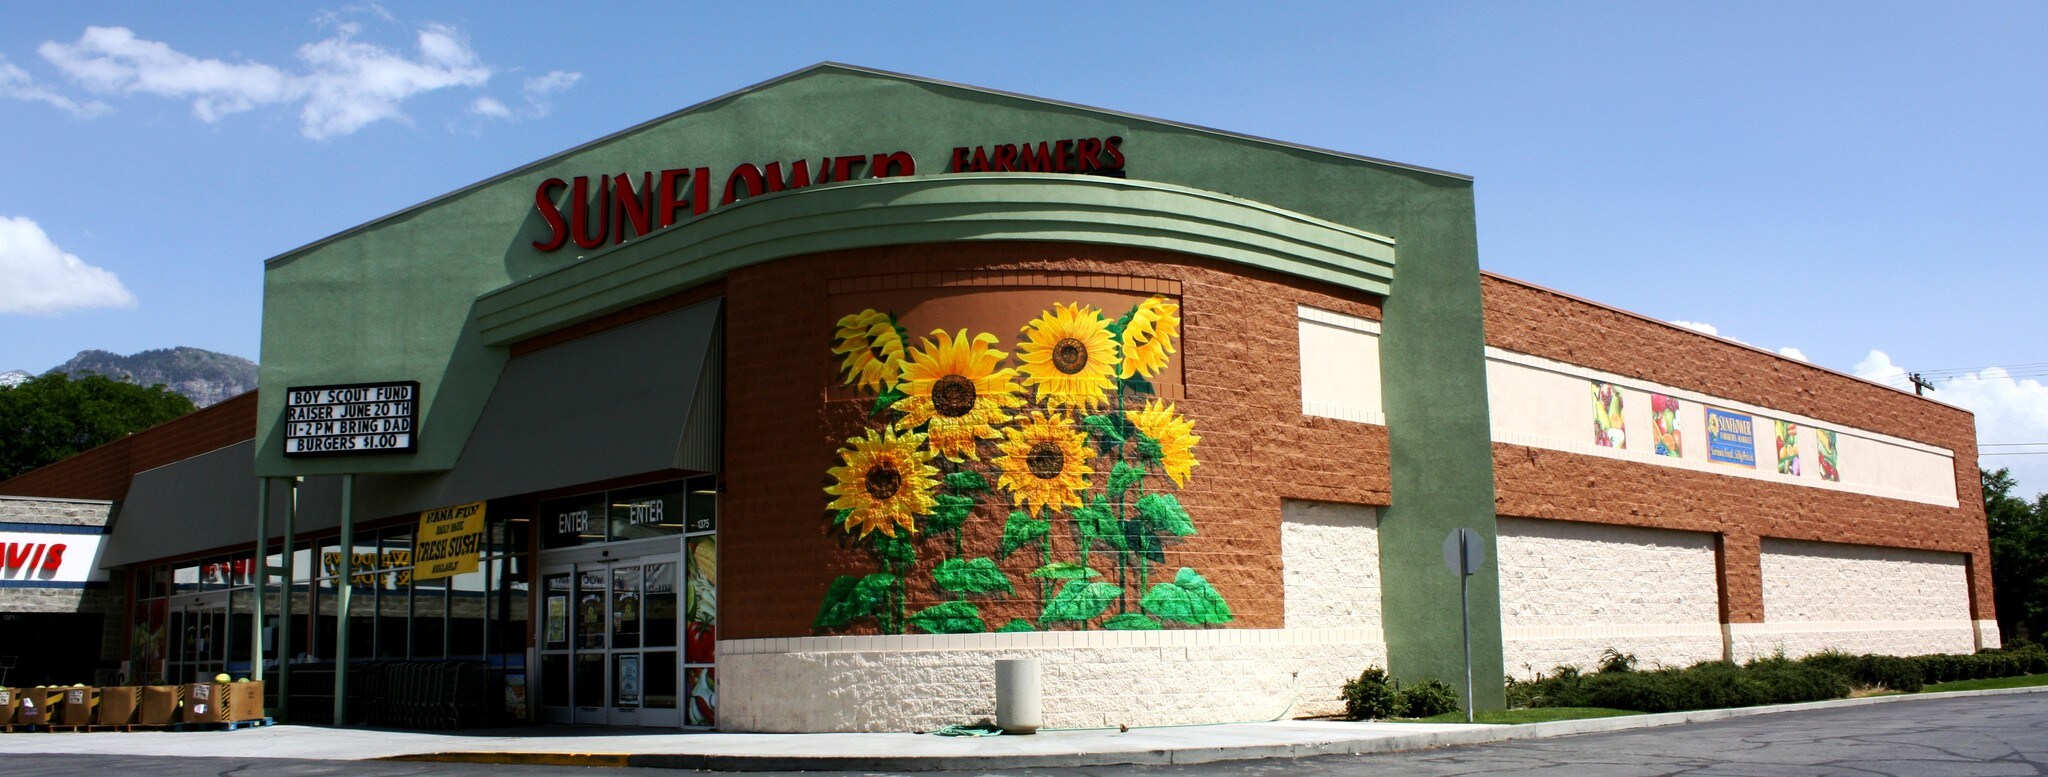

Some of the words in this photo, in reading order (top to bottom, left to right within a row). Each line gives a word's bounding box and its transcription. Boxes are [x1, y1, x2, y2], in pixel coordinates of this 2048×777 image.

[953, 136, 1125, 173] FARMERS
[295, 391, 320, 404] BOY
[328, 388, 370, 403] SCOUT
[377, 386, 409, 400] FUND
[289, 406, 333, 420] RAISER
[341, 404, 371, 418] JUNE
[374, 403, 390, 416] 20
[394, 401, 410, 415] TH
[340, 419, 378, 433] BRING
[384, 417, 410, 432] DAD
[1719, 416, 1751, 435] SUNFLOWER
[297, 436, 356, 451] BURGERS
[363, 434, 397, 448] $1.00
[426, 509, 453, 523] HANA
[630, 499, 664, 525] ENTER
[559, 510, 589, 534] ENTER
[697, 519, 710, 529] 1375
[0, 542, 67, 571] VIS
[416, 538, 448, 562] FRESH
[448, 532, 482, 557] SUSHI
[432, 562, 459, 573] AVAILABLE
